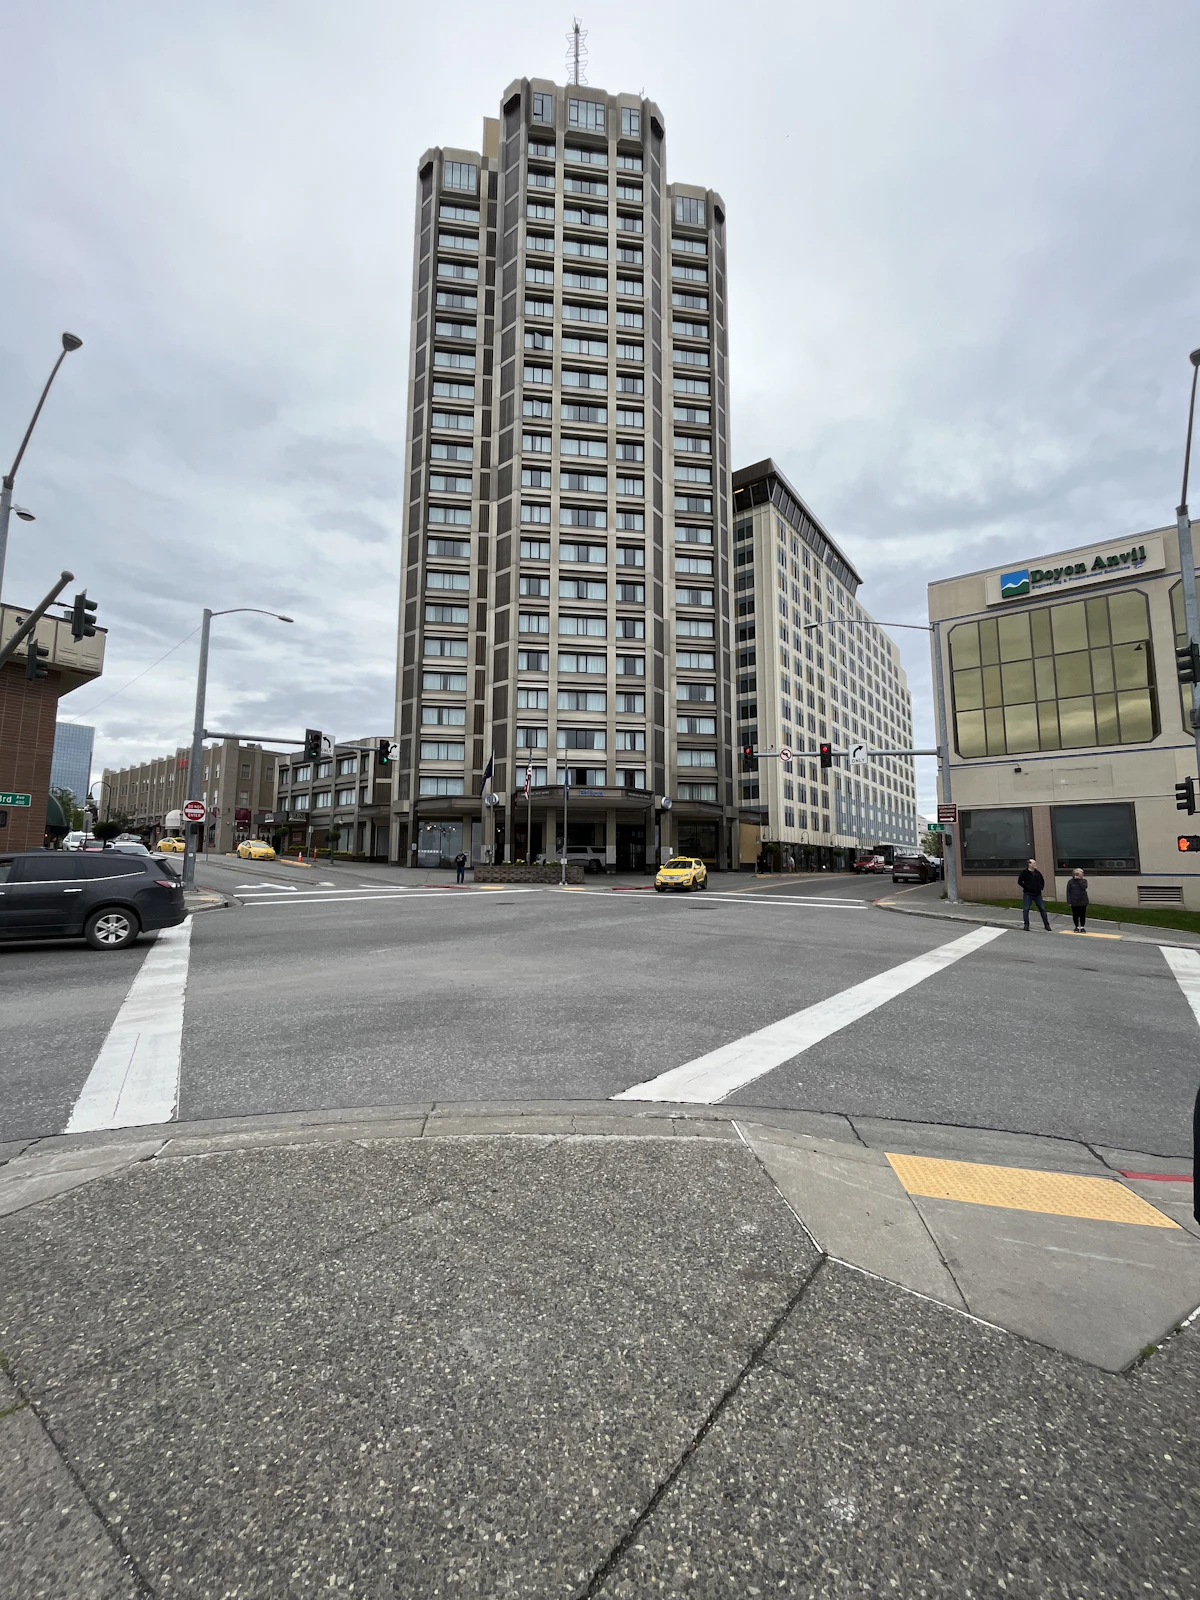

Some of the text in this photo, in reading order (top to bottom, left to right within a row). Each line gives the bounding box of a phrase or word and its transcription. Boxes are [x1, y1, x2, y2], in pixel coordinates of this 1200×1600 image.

[1030, 546, 1147, 583] Doyon Anvil
[1032, 579, 1062, 590] Engineering
[1069, 571, 1103, 582] Procurement
[1104, 565, 1131, 574] Solutions
